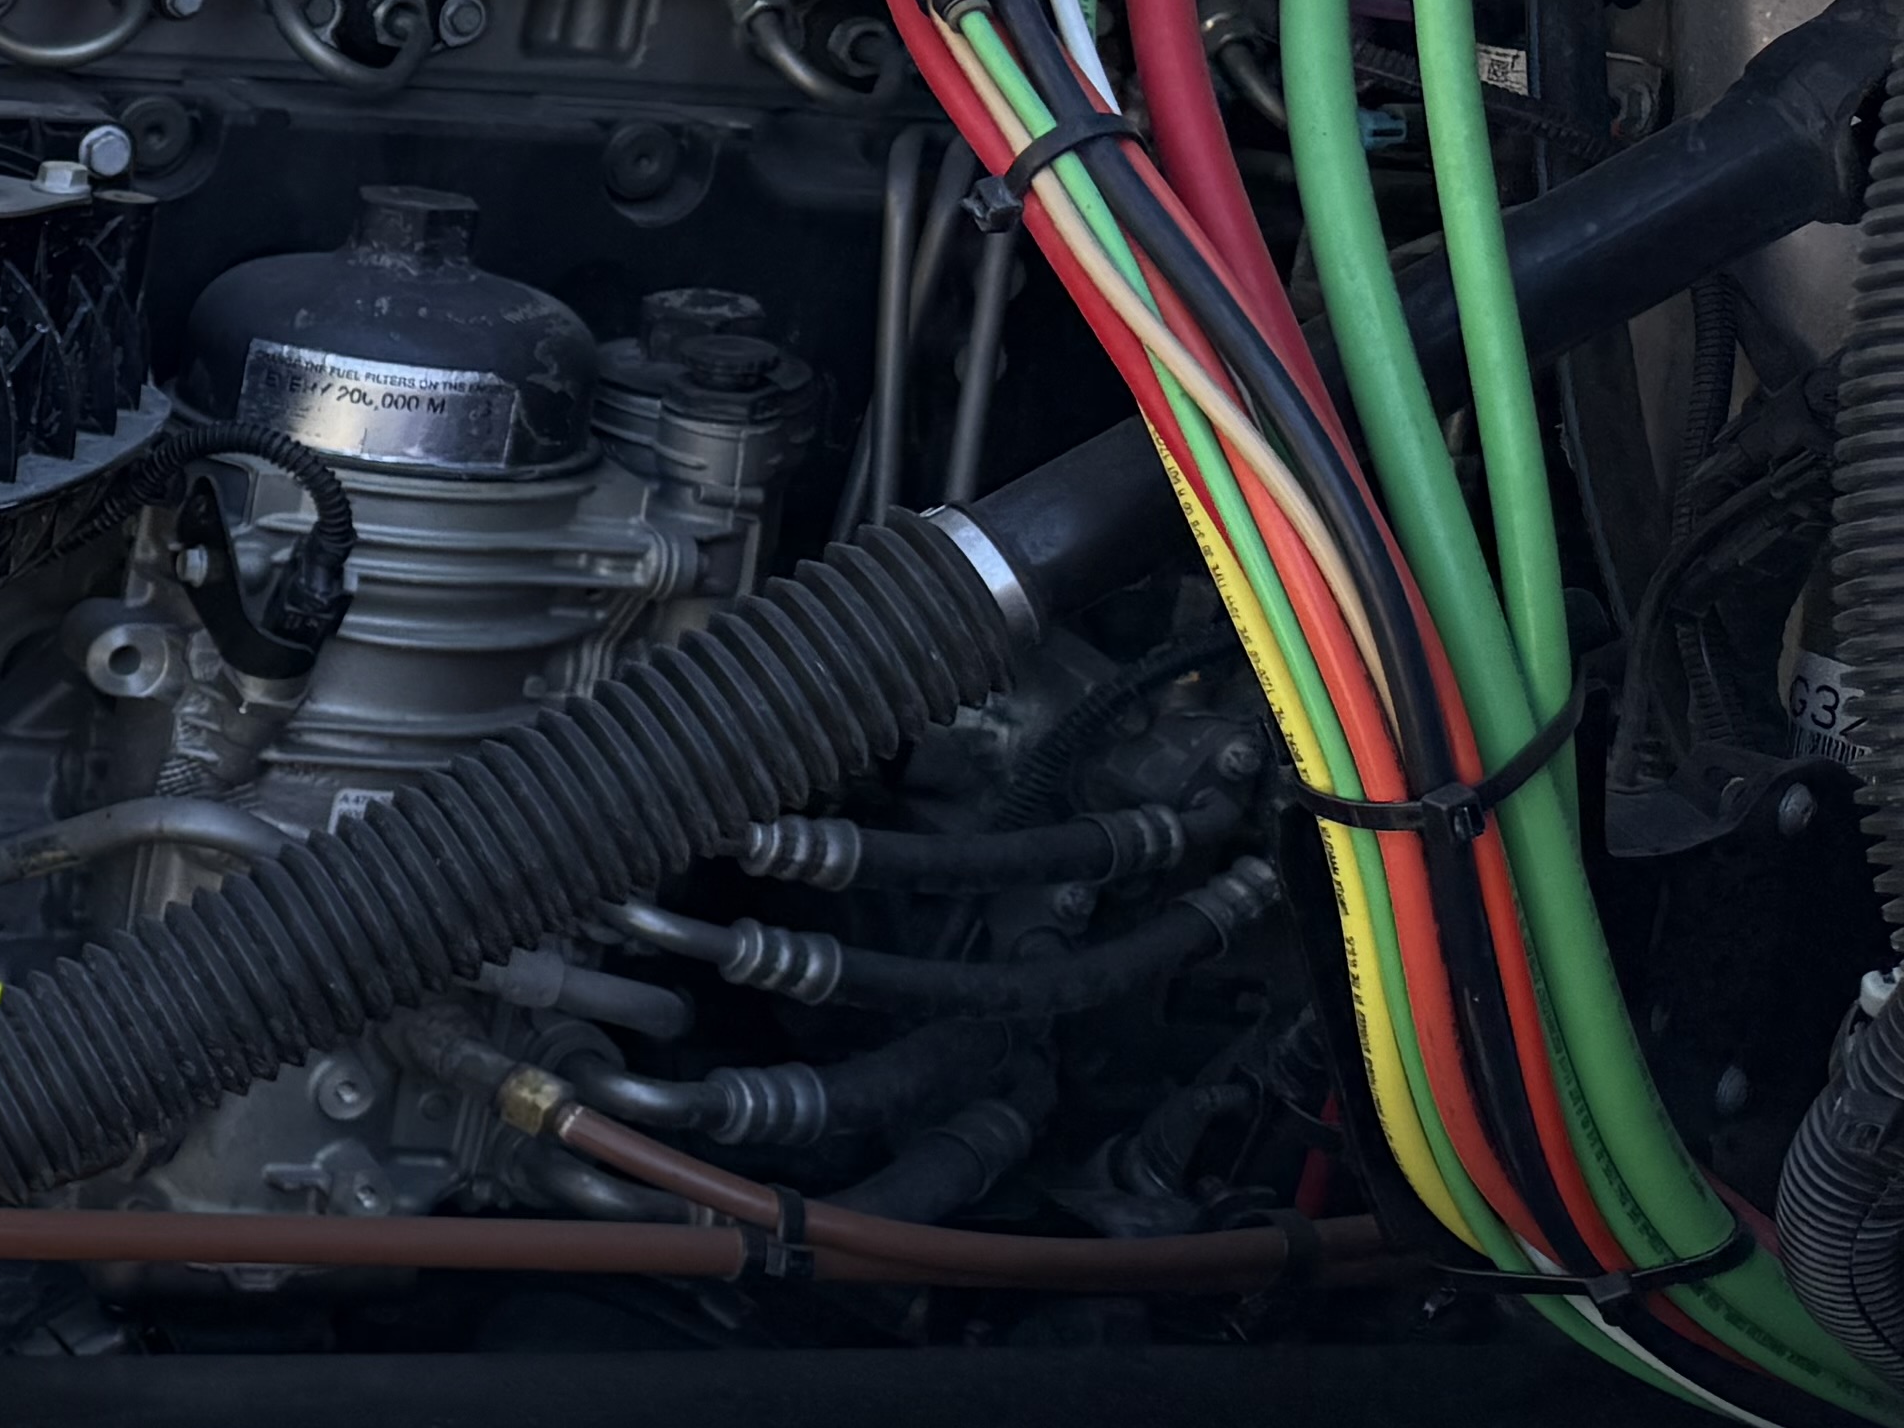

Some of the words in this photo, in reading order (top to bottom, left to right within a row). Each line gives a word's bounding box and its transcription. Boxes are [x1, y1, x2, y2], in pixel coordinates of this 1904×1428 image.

[329, 365, 361, 381] FUEL
[365, 372, 415, 389] FILTERS
[419, 378, 437, 389] ON
